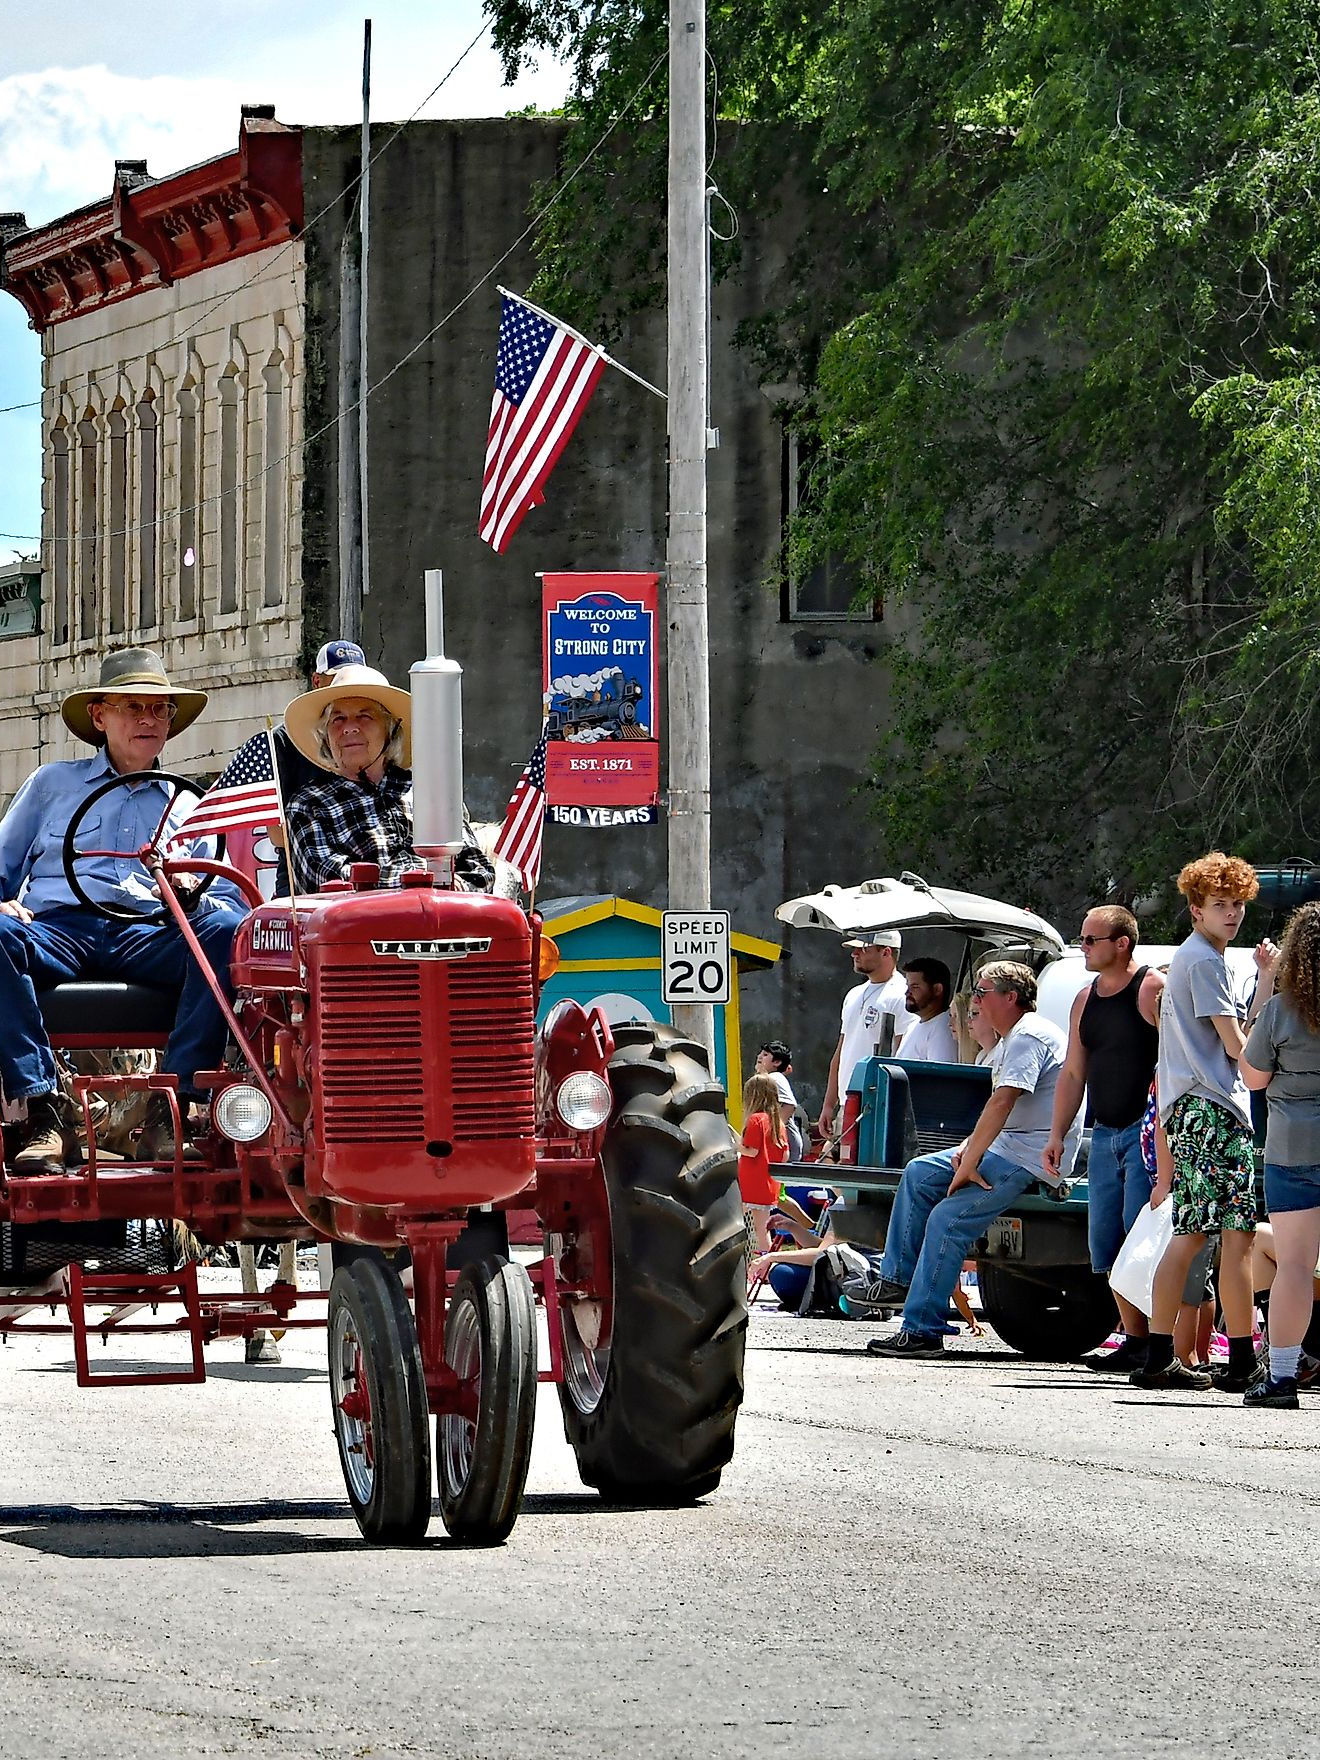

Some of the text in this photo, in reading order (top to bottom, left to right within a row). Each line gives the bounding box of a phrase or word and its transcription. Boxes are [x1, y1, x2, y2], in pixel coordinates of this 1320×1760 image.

[564, 609, 637, 621] WELCOME
[590, 623, 611, 634] TO
[554, 638, 646, 655] STRONG CITY
[569, 758, 633, 770] EST. 1871
[551, 806, 651, 826] 150 YEARS
[667, 922, 724, 935] SPEED
[260, 930, 294, 950] FARMALL
[381, 941, 486, 953] FARMALL
[674, 941, 718, 954] LIMIT
[668, 960, 724, 994] 20
